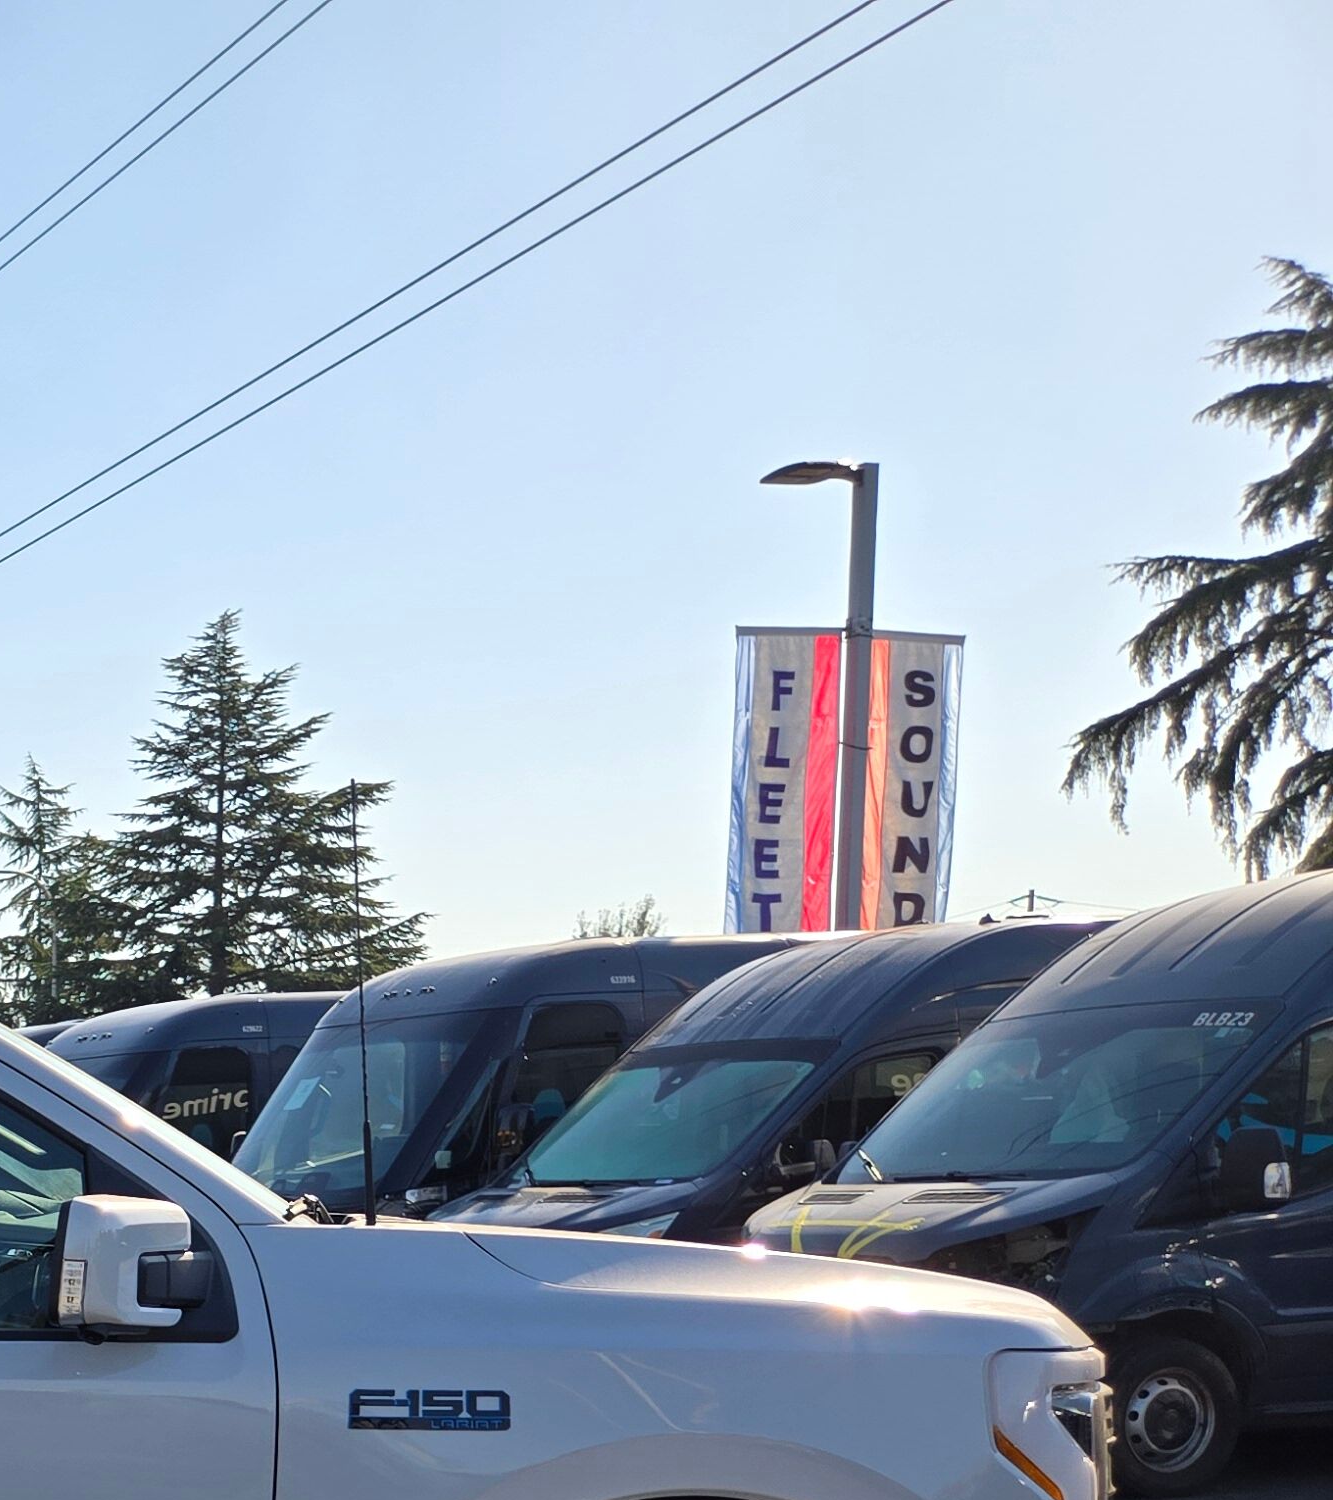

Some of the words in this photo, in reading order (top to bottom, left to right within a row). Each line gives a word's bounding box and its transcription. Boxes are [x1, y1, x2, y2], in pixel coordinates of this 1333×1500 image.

[751, 670, 796, 931] FLEET
[891, 670, 936, 927] SOUND
[1192, 1012, 1254, 1027] BLBZ3
[348, 1388, 511, 1417] F-150
[430, 1420, 503, 1429] LARIAT
